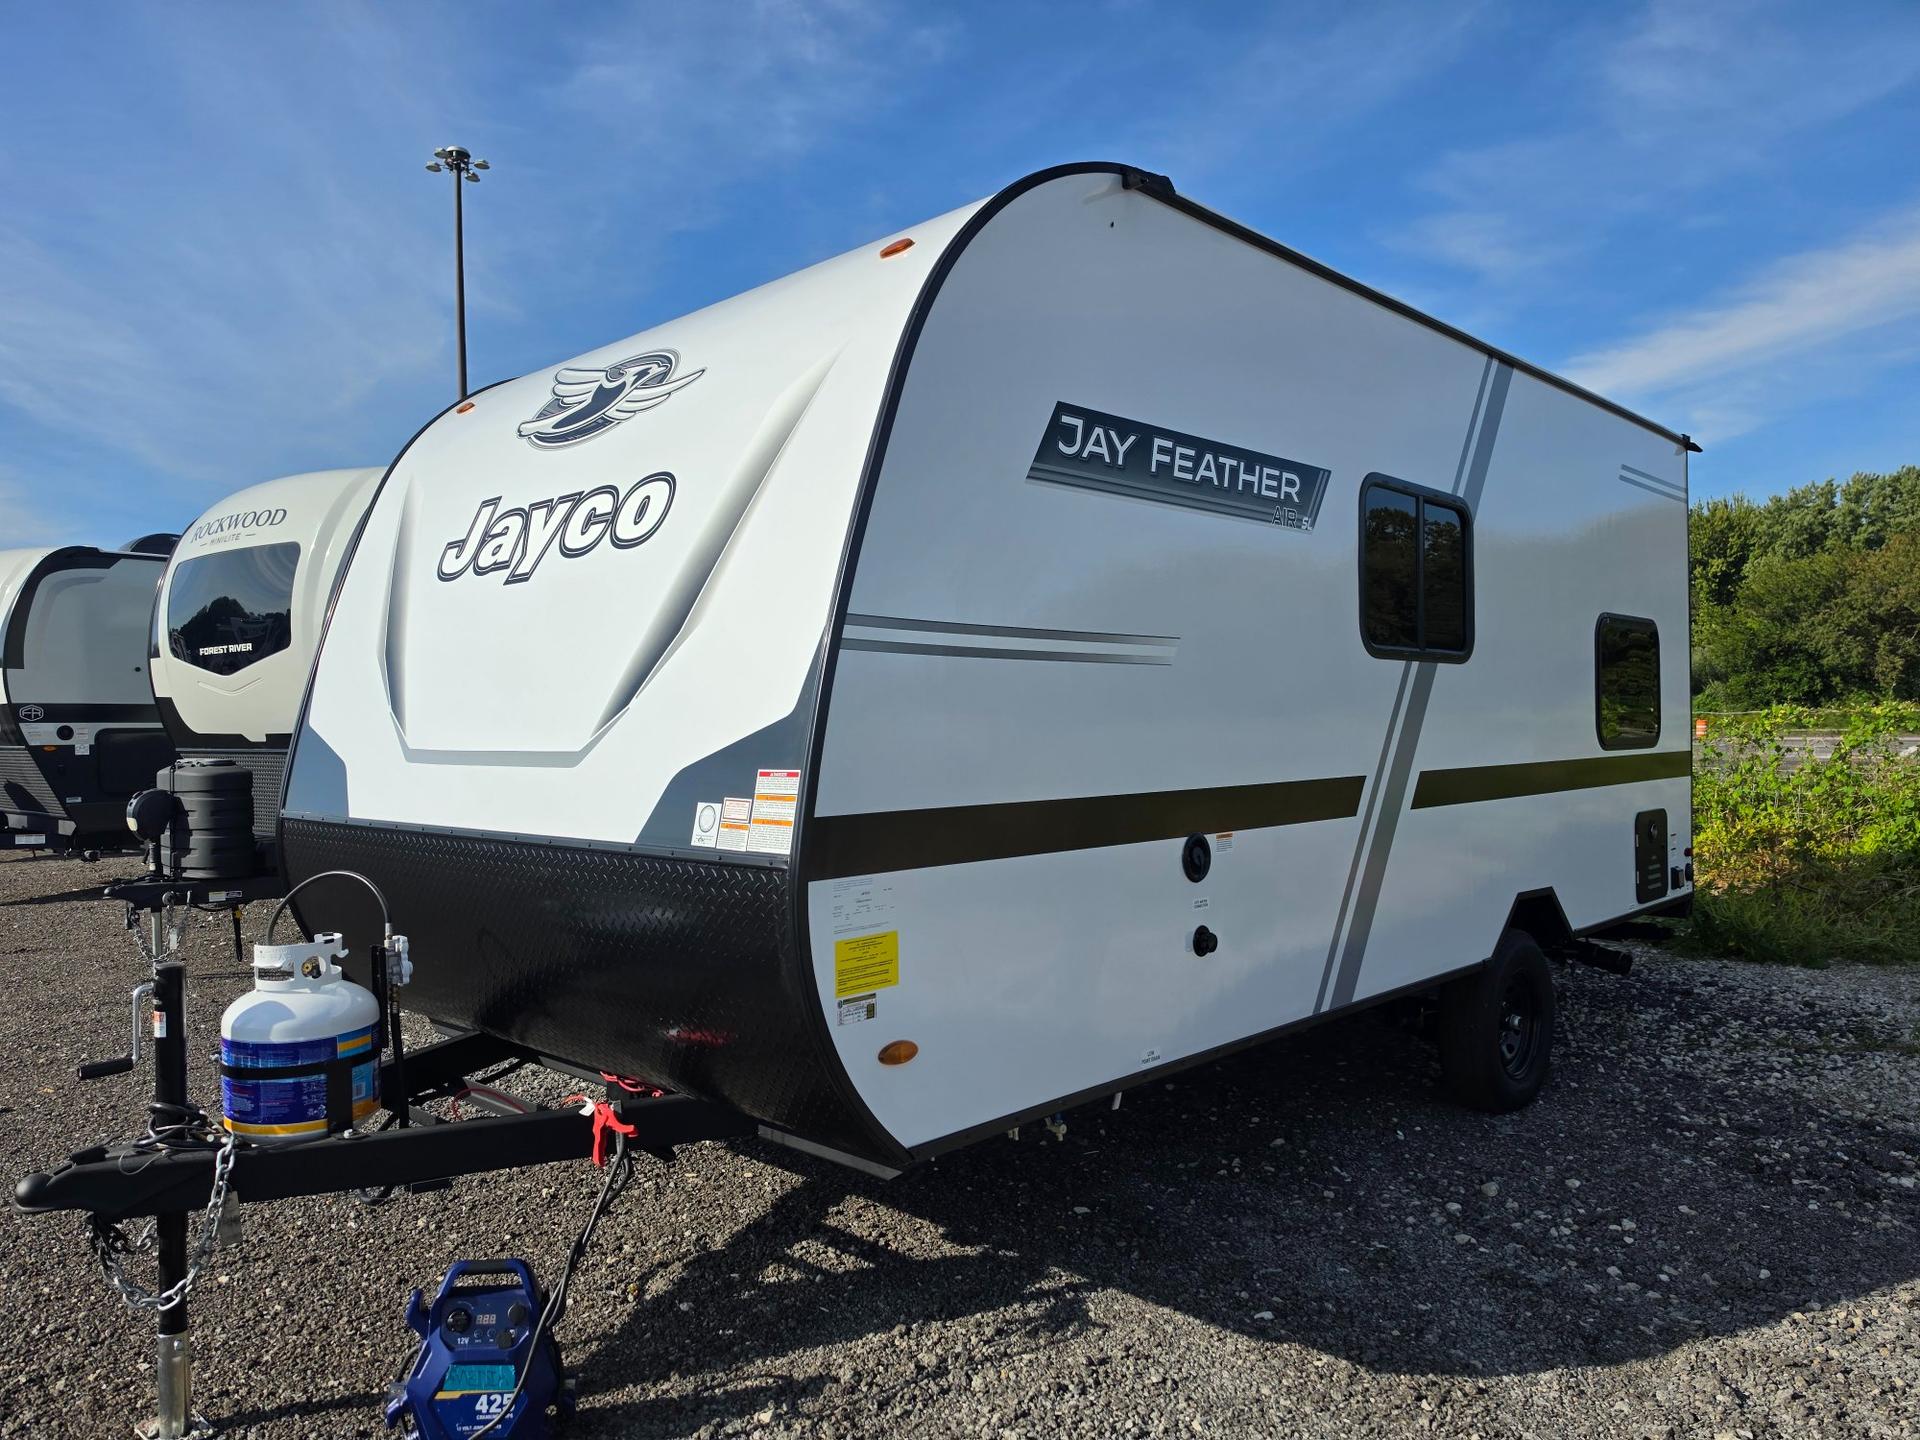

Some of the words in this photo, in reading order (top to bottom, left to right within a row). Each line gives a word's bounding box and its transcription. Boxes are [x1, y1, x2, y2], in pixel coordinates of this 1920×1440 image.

[1057, 414, 1139, 467] JAY
[1149, 436, 1301, 504] FEATHER
[190, 508, 288, 544] ROCKWOOD
[436, 470, 677, 586] Jayco
[1271, 505, 1298, 530] AIR
[199, 645, 228, 656] FOREST
[228, 642, 253, 653] RIVER
[474, 1393, 516, 1414] 425
